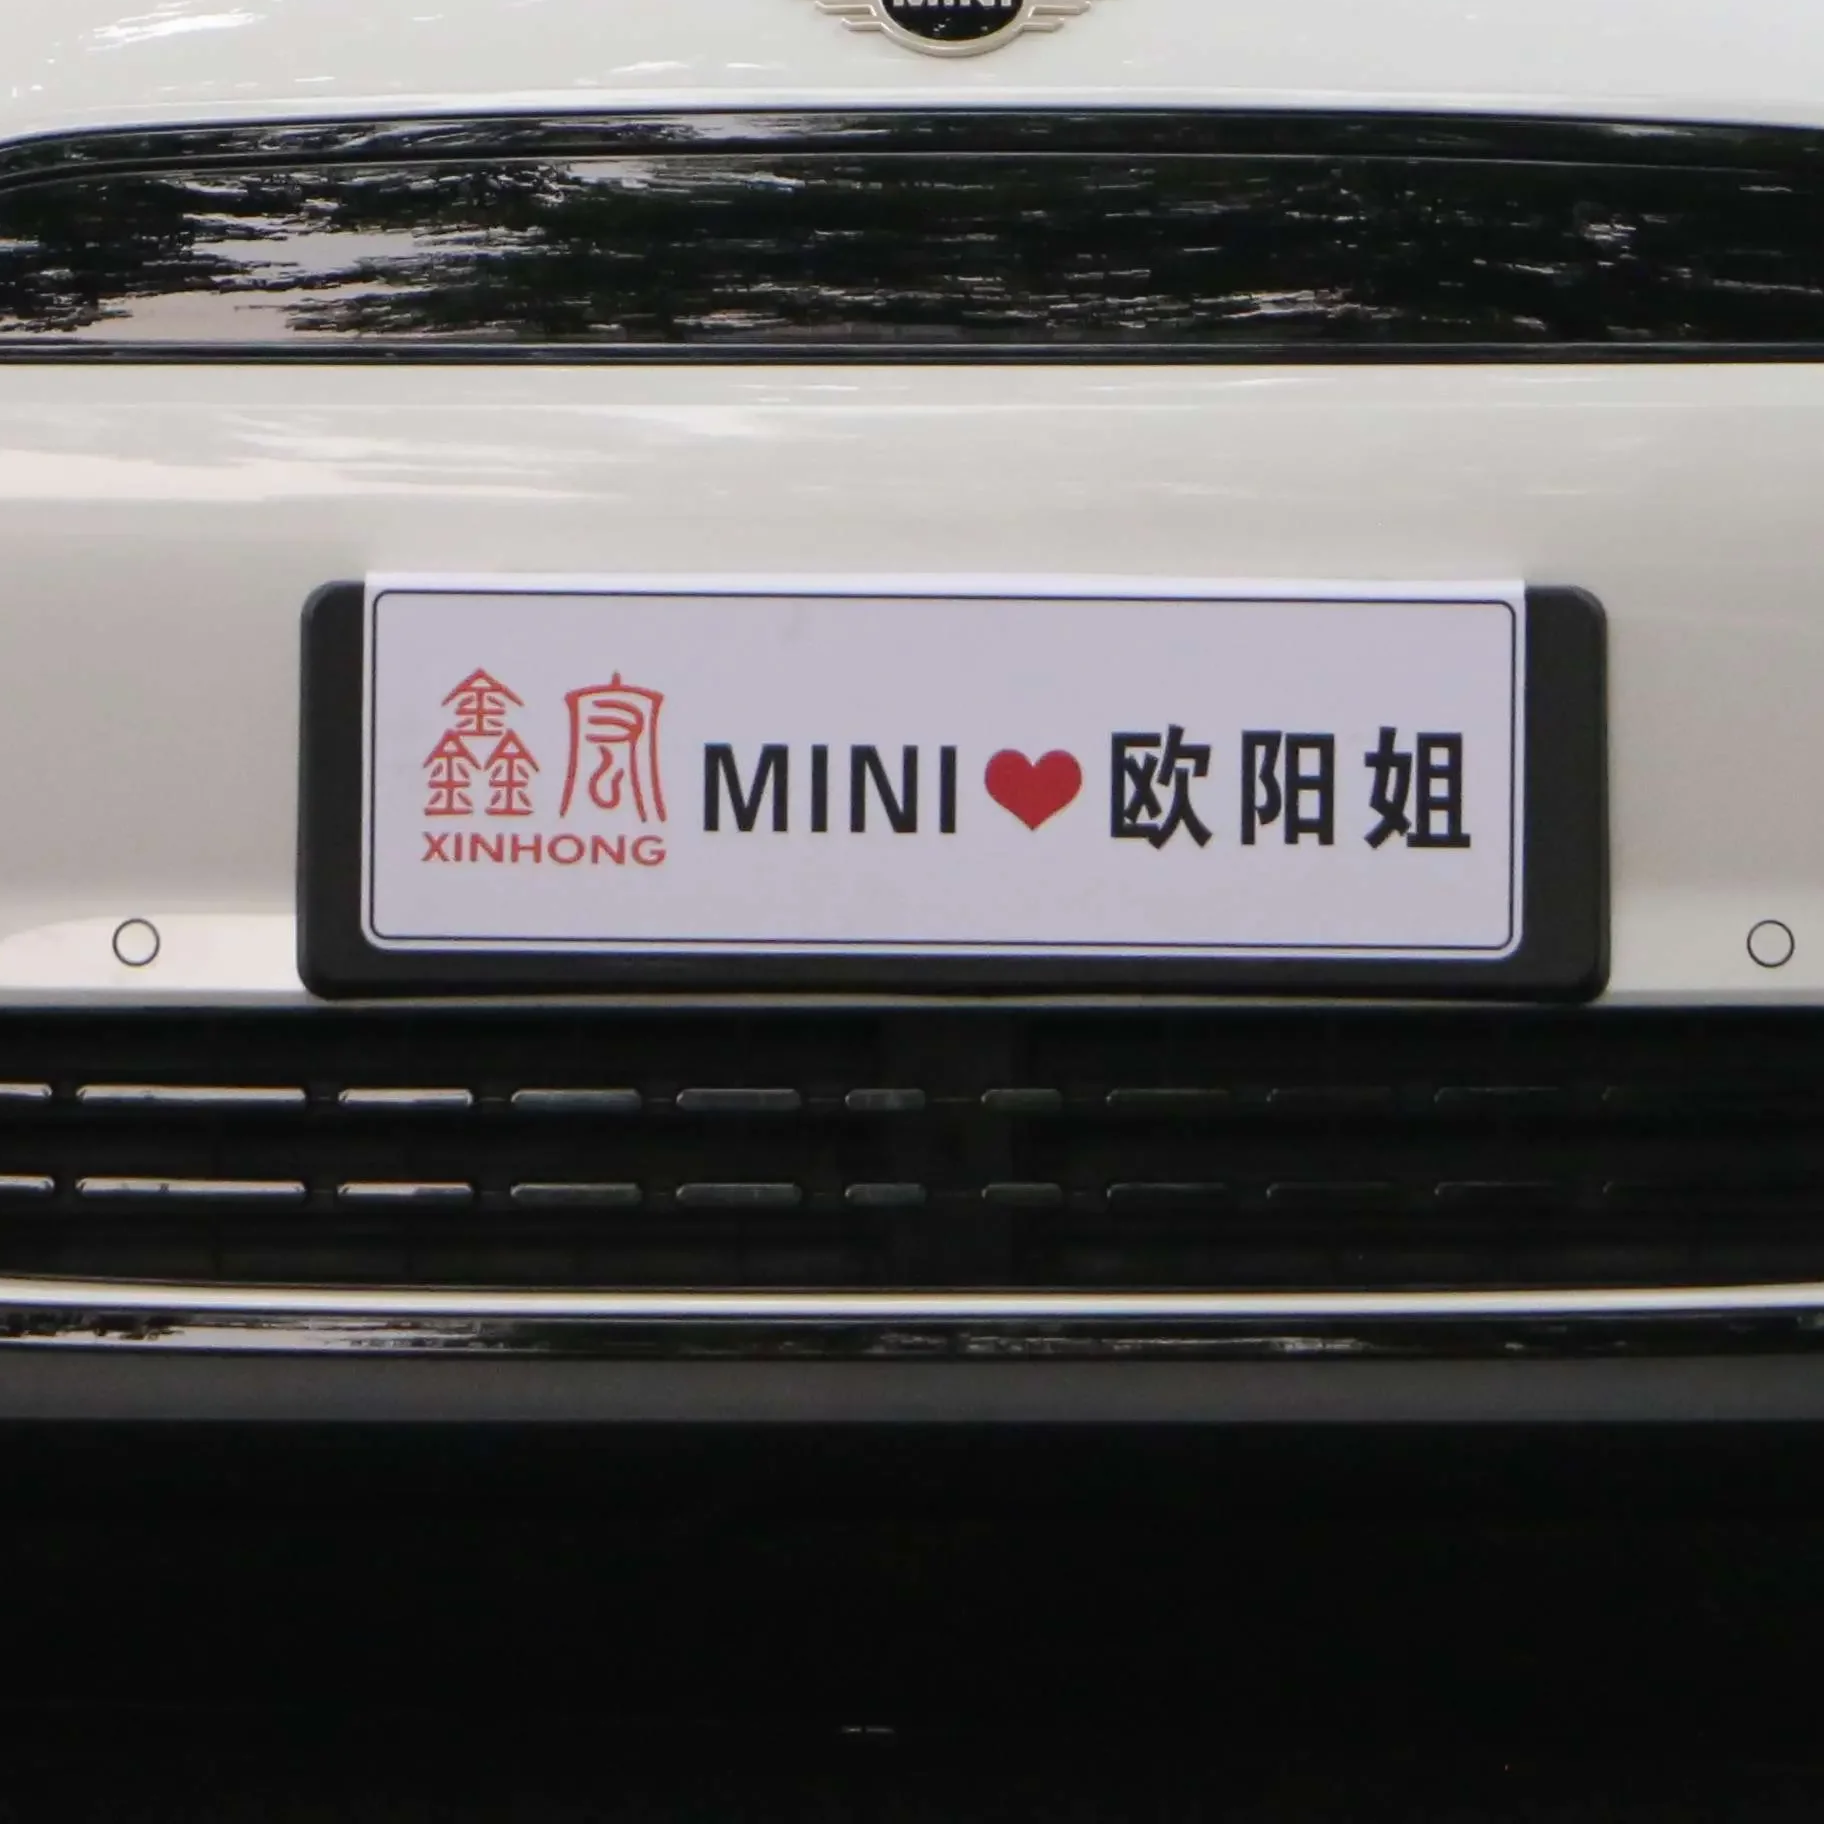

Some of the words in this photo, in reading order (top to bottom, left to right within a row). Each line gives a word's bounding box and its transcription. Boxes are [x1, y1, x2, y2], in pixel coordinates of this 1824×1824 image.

[704, 741, 958, 834] MINI
[1109, 725, 1472, 850] 欧阳姐
[421, 831, 667, 867] XINHONG
